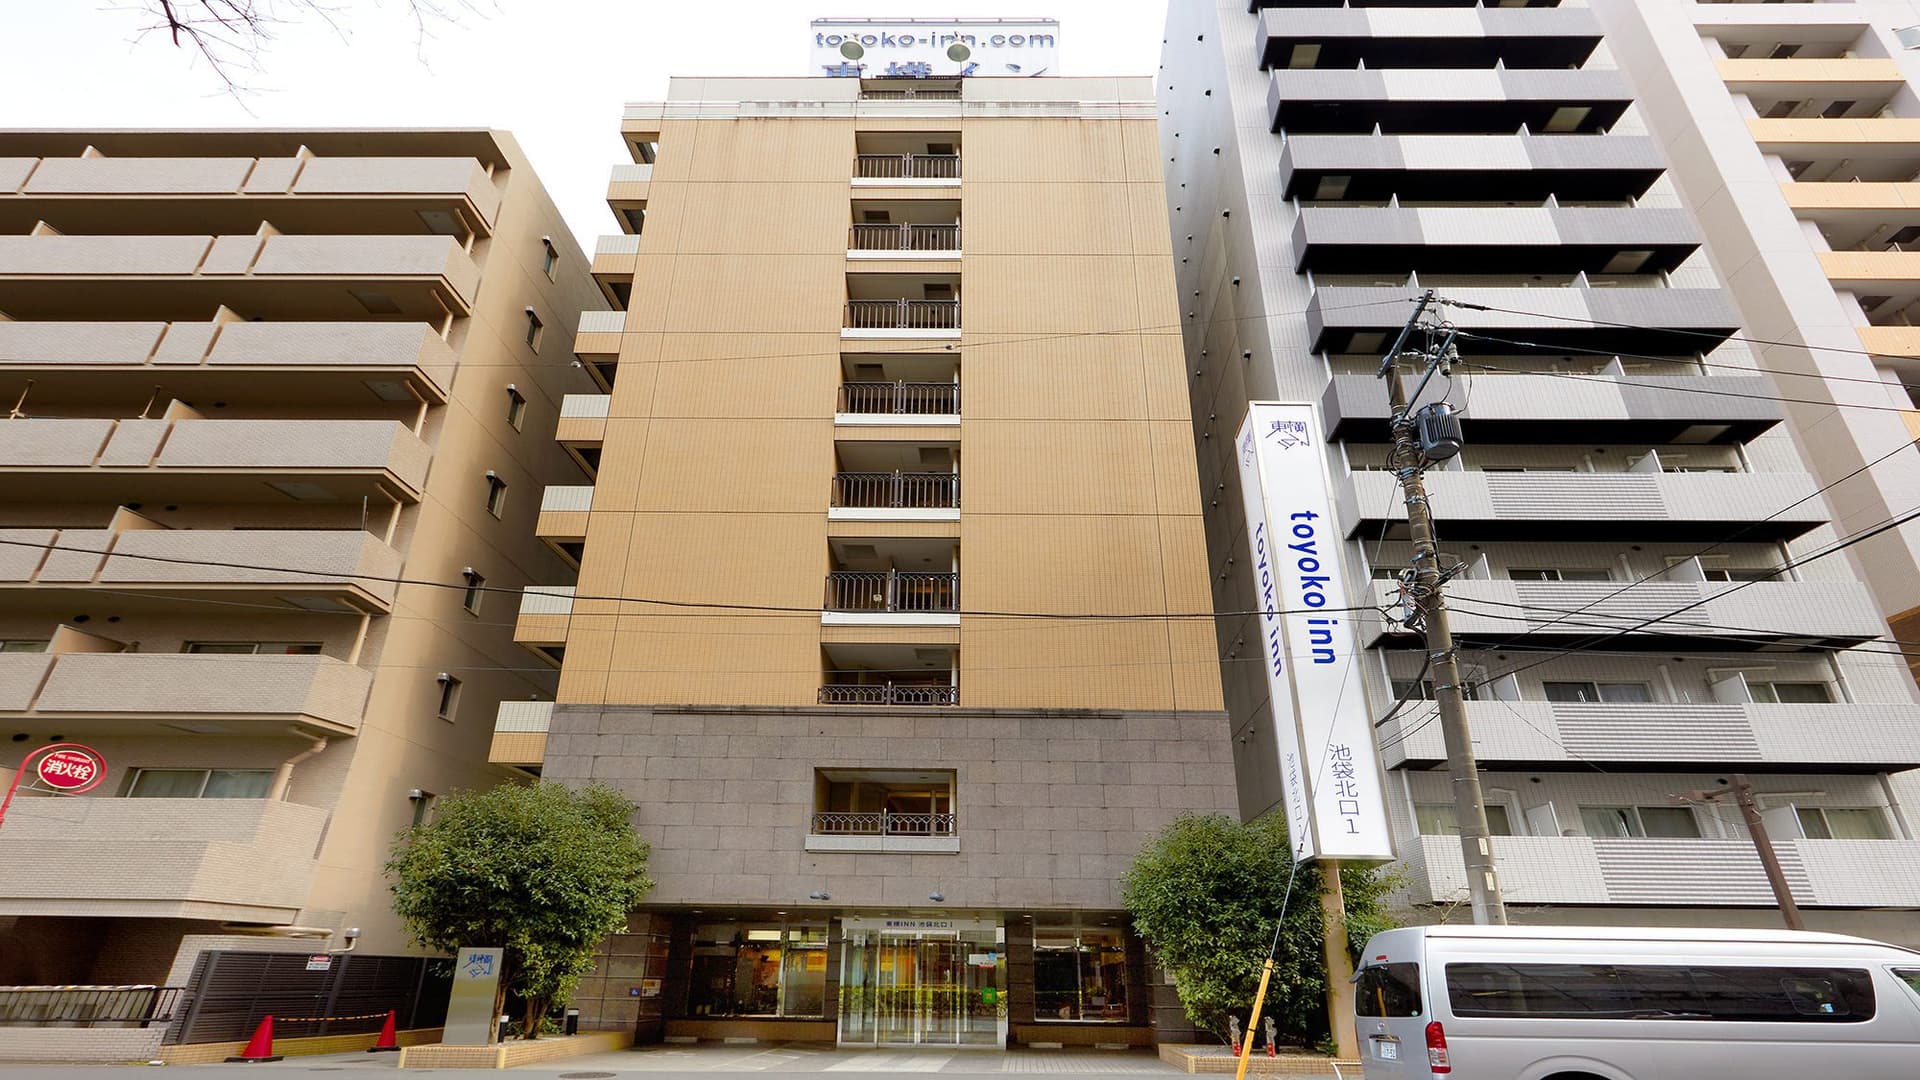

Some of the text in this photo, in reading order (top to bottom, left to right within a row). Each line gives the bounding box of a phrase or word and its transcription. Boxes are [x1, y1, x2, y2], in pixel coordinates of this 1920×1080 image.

[1255, 522, 1282, 677] toyoko inn
[1287, 510, 1338, 664] toyoko inn
[43, 759, 92, 780] 消火栓
[1329, 743, 1360, 834] 池袋北口1
